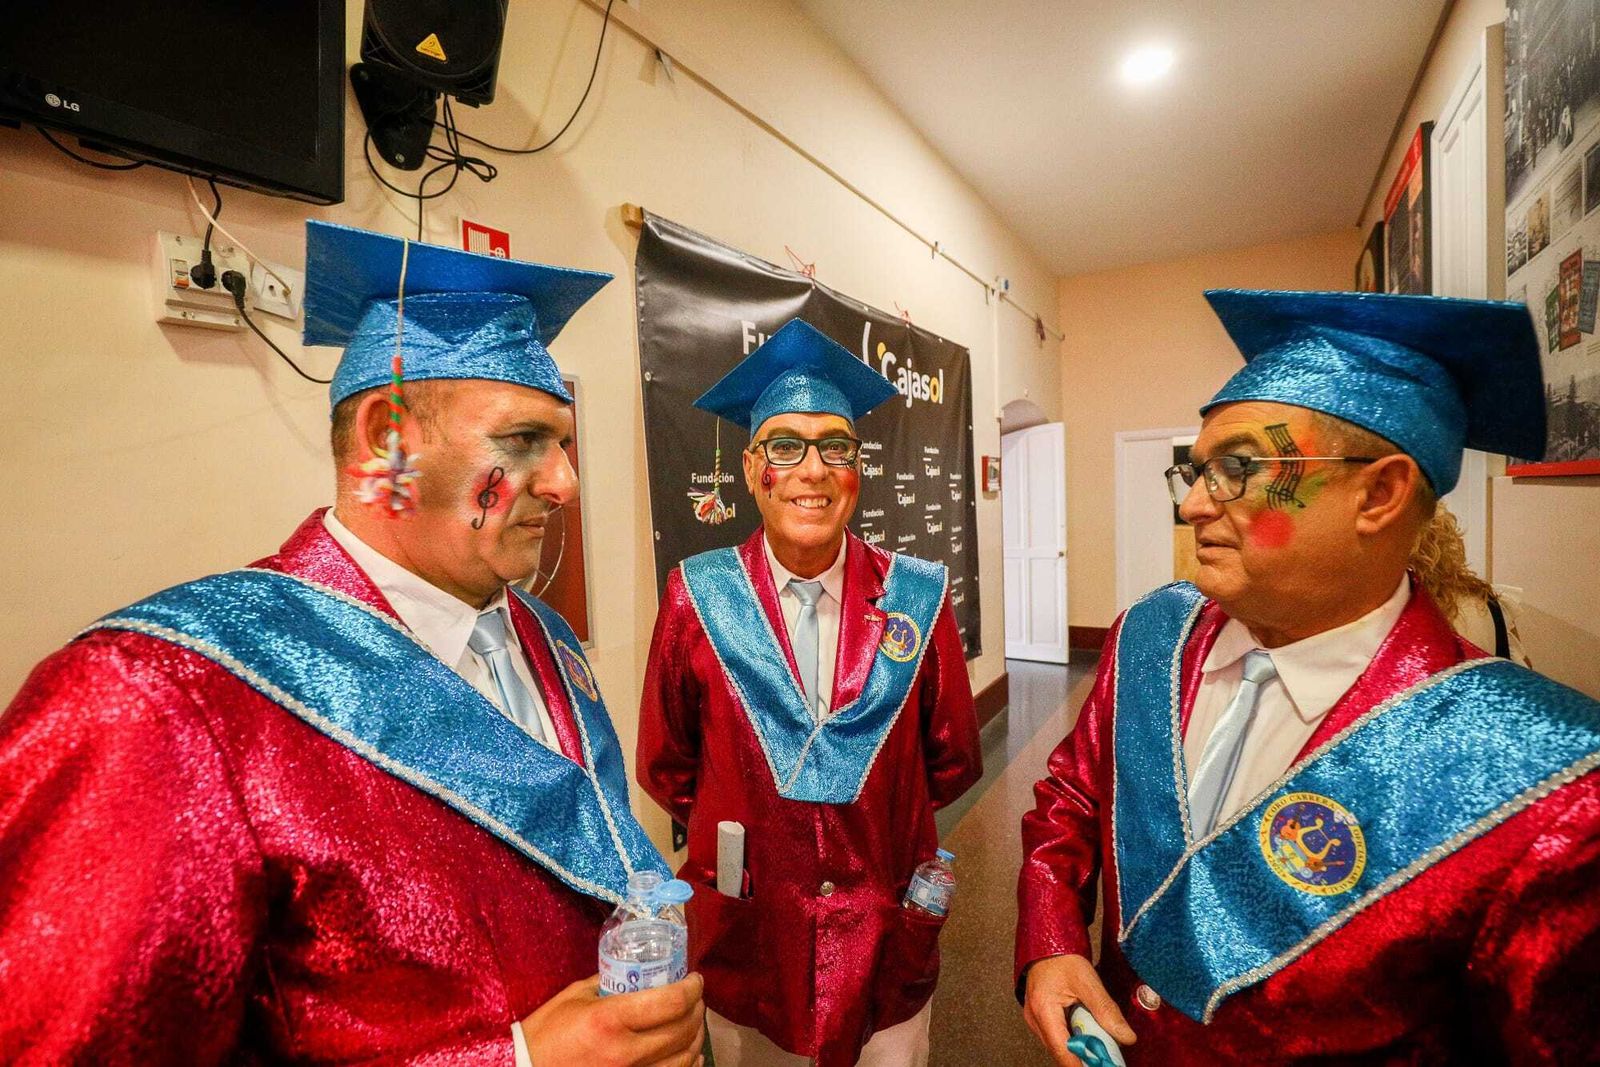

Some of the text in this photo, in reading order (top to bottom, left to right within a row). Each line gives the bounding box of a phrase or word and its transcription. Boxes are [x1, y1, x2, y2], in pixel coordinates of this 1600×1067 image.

[63, 100, 80, 112] LG
[881, 350, 944, 409] Cajasol
[691, 471, 735, 484] Fundción
